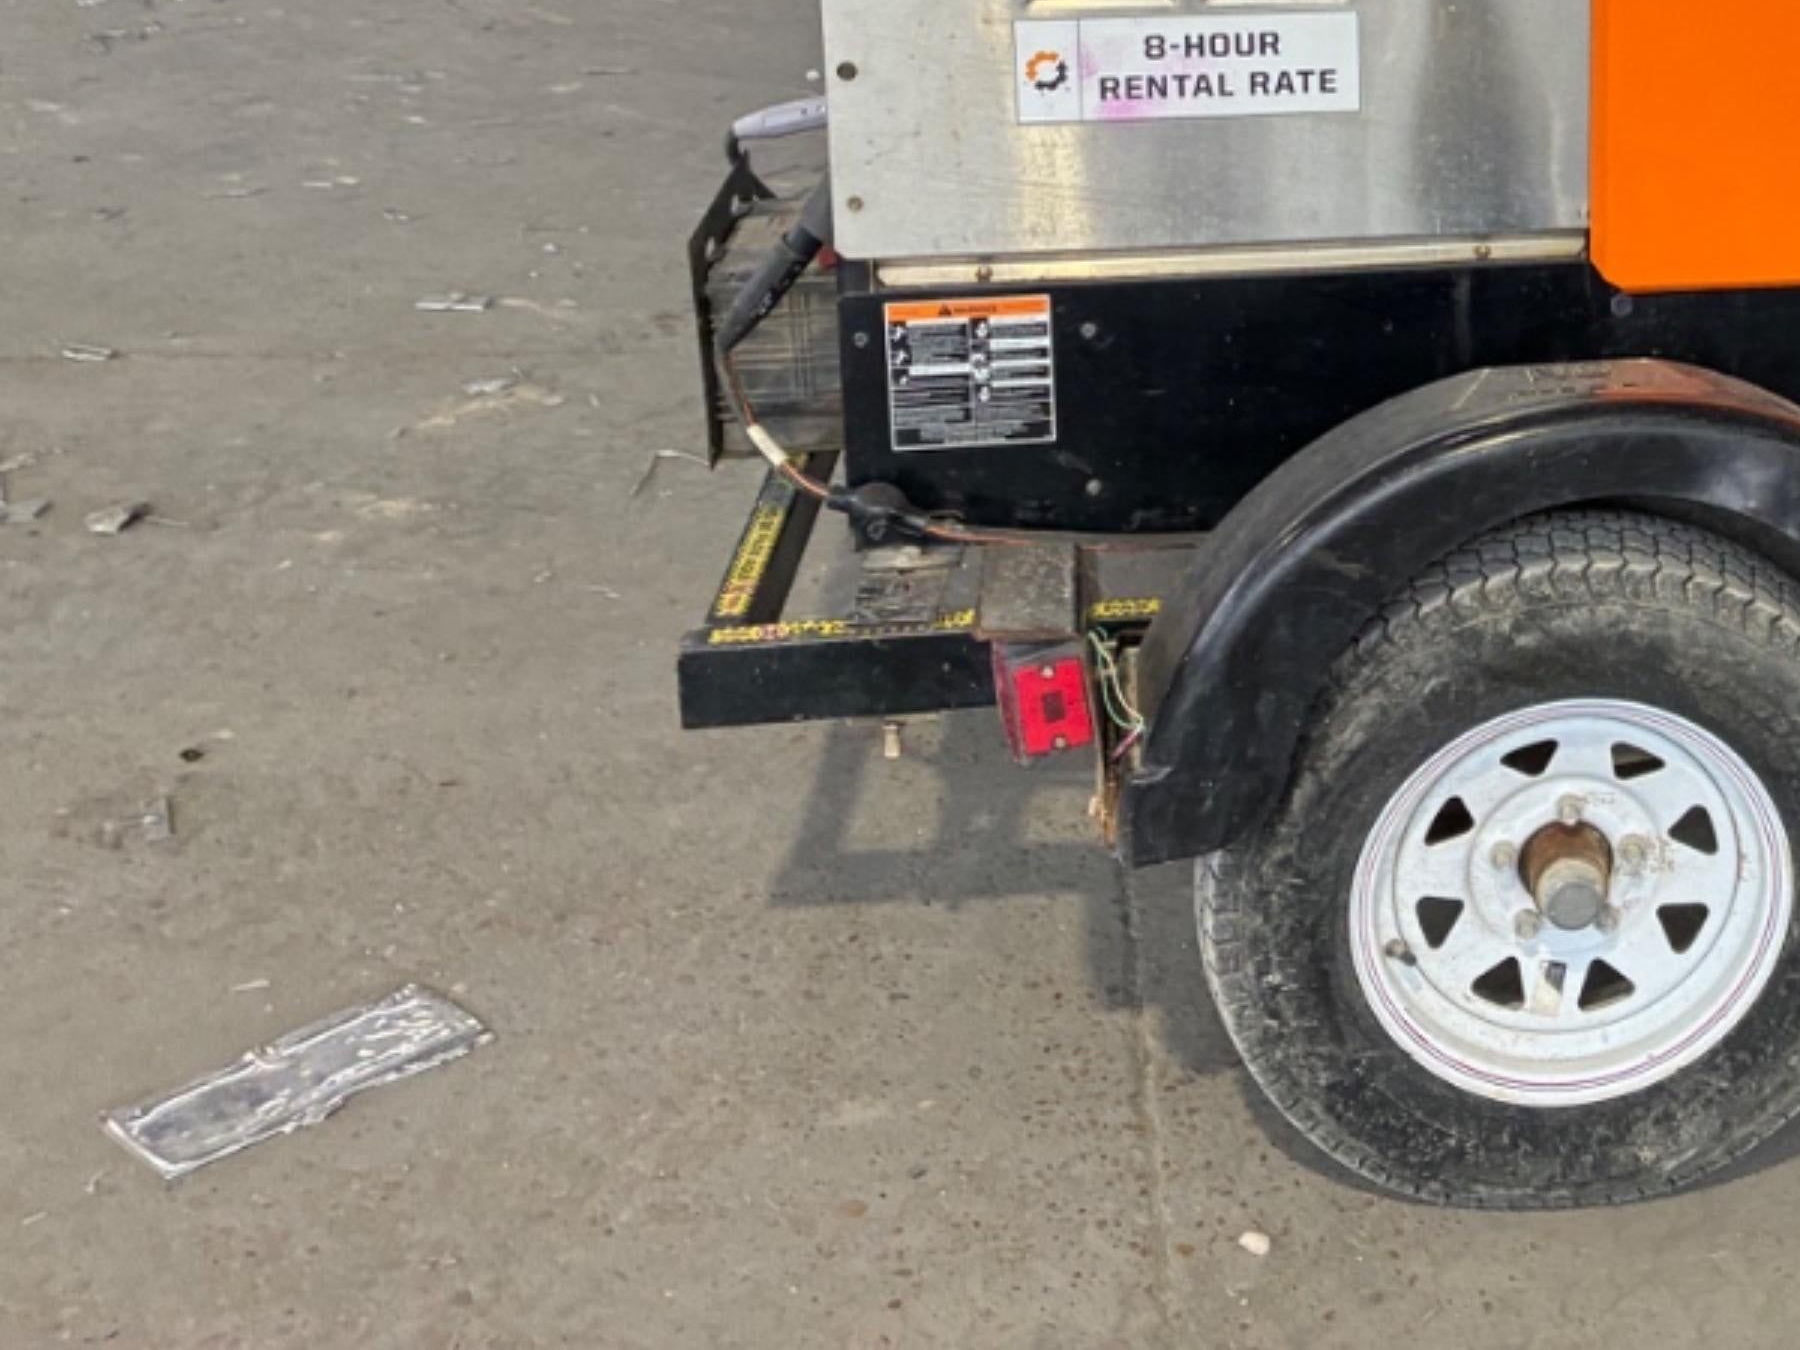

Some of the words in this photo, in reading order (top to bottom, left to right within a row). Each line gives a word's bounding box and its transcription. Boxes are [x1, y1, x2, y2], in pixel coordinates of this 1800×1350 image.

[1143, 31, 1281, 61] 8-HOUR
[1100, 72, 1235, 102] RENTAL
[1249, 68, 1338, 97] RATE
